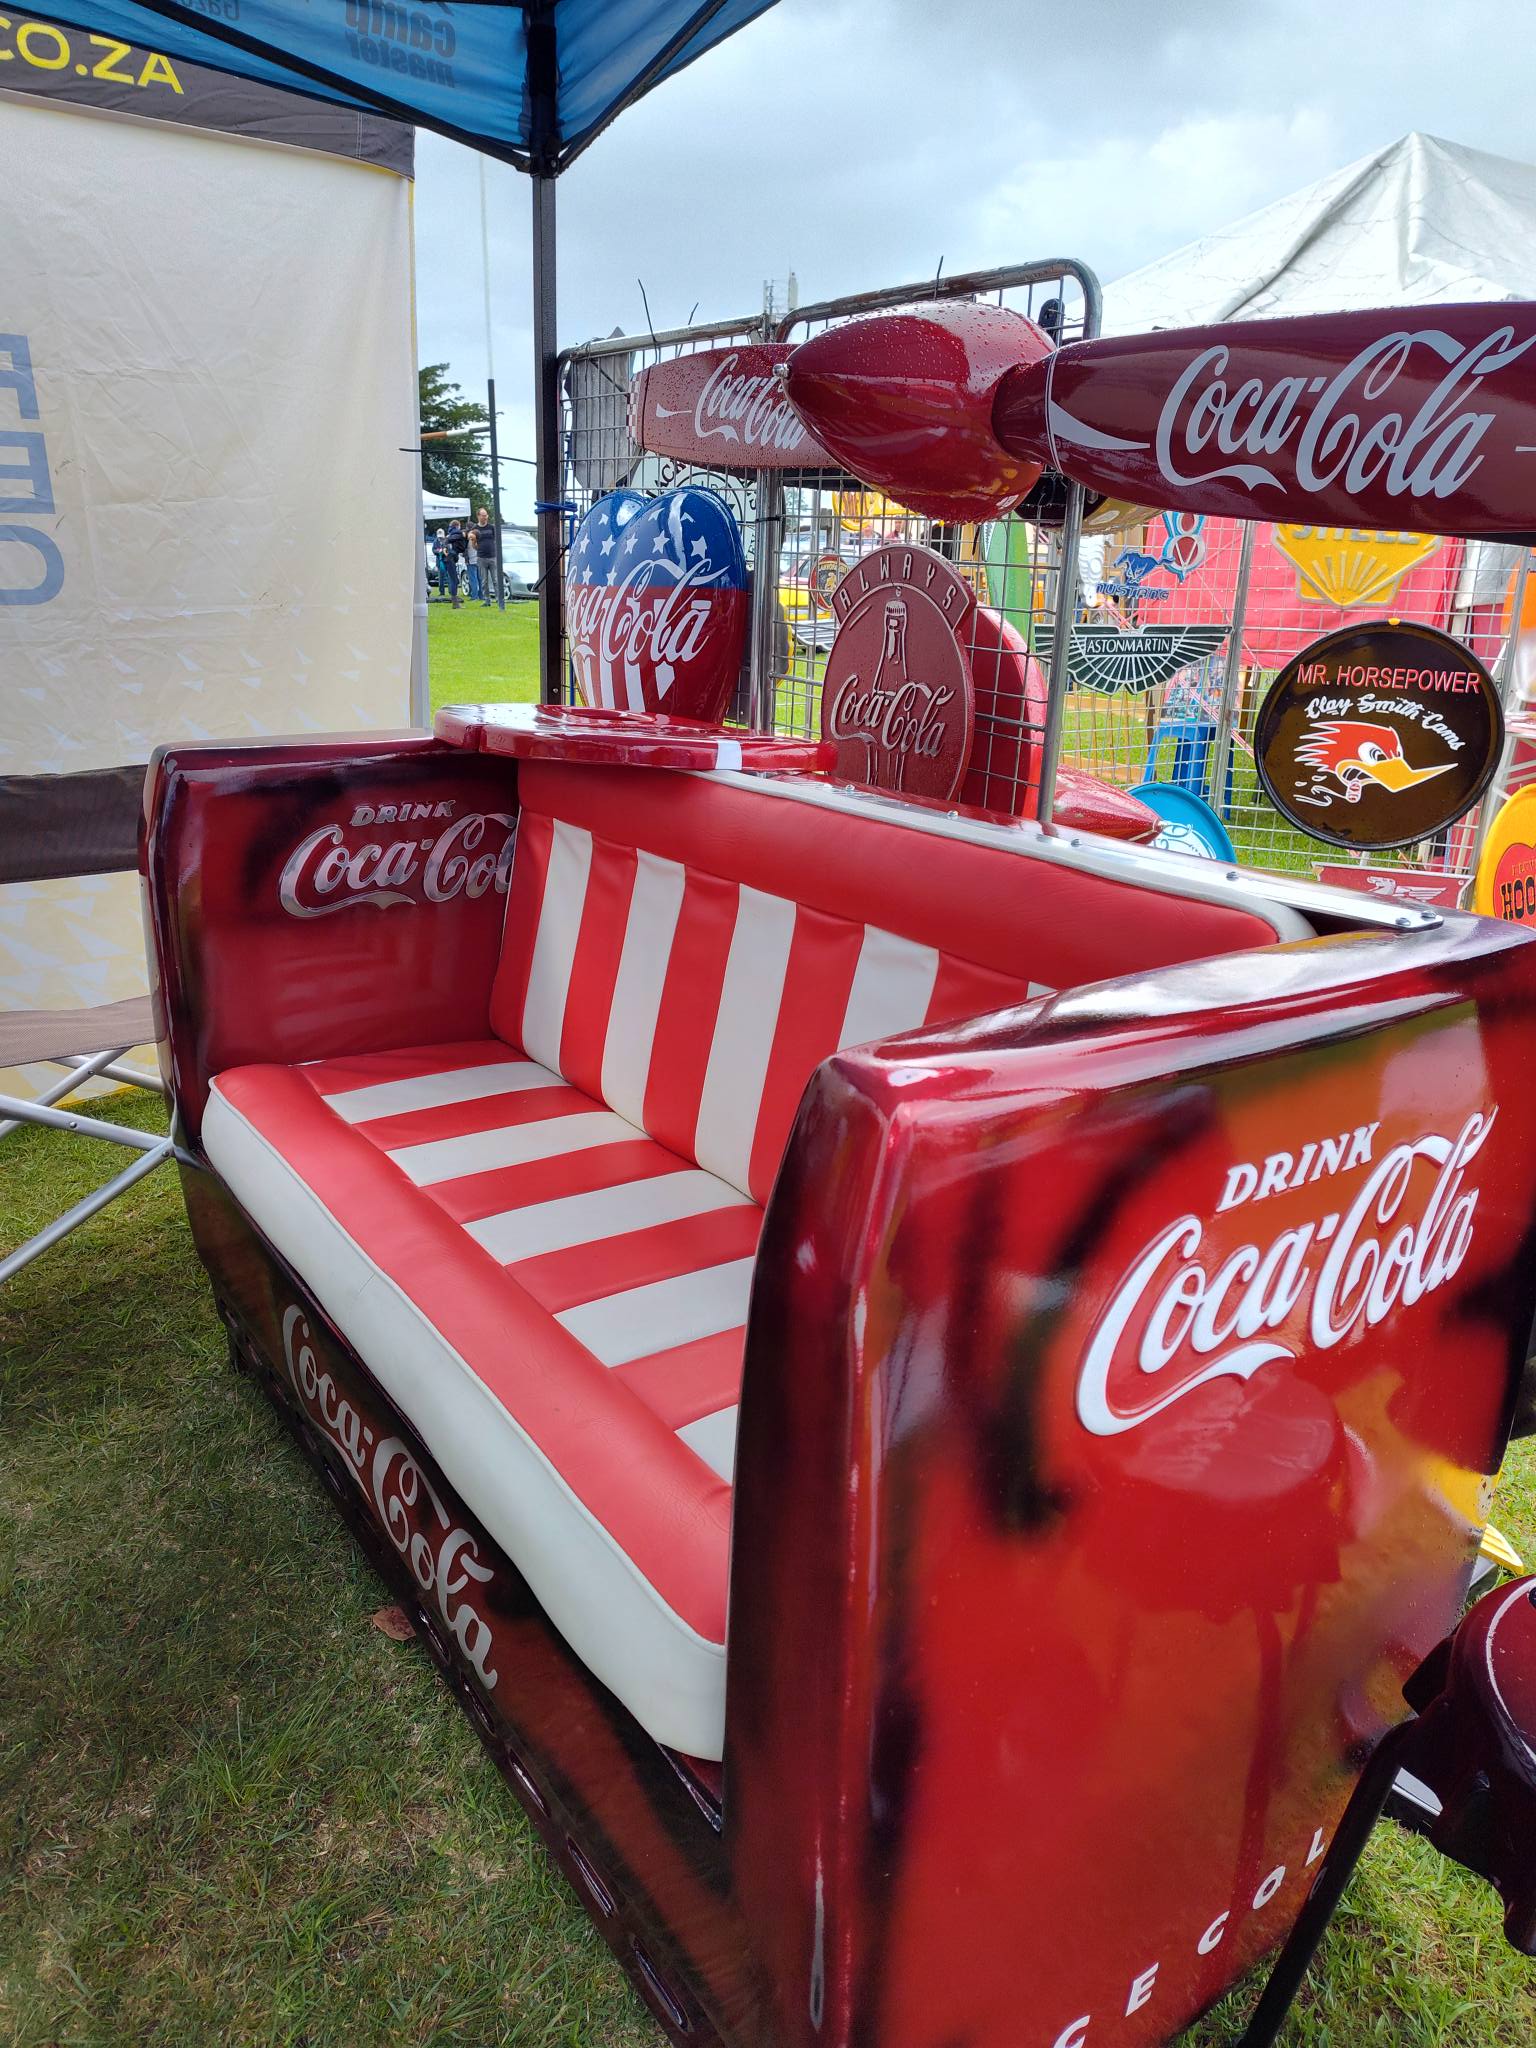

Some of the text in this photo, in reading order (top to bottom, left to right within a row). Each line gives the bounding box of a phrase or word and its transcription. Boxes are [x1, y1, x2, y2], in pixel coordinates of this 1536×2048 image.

[1156, 325, 1536, 498] Coca-Cola
[839, 553, 957, 611] ALWAYS
[1096, 582, 1170, 600] MUSTANG
[831, 673, 955, 758] Coca-Cola
[1297, 664, 1482, 695] MR. HORSEPOWER
[1304, 693, 1466, 751] Clay Smith Cams
[351, 799, 457, 828] DRINK
[279, 812, 517, 919] Coca-Col
[1216, 1121, 1381, 1214] DRINK
[1077, 1105, 1499, 1437] Coca-Cola
[282, 1303, 499, 1691] Coca-Cola
